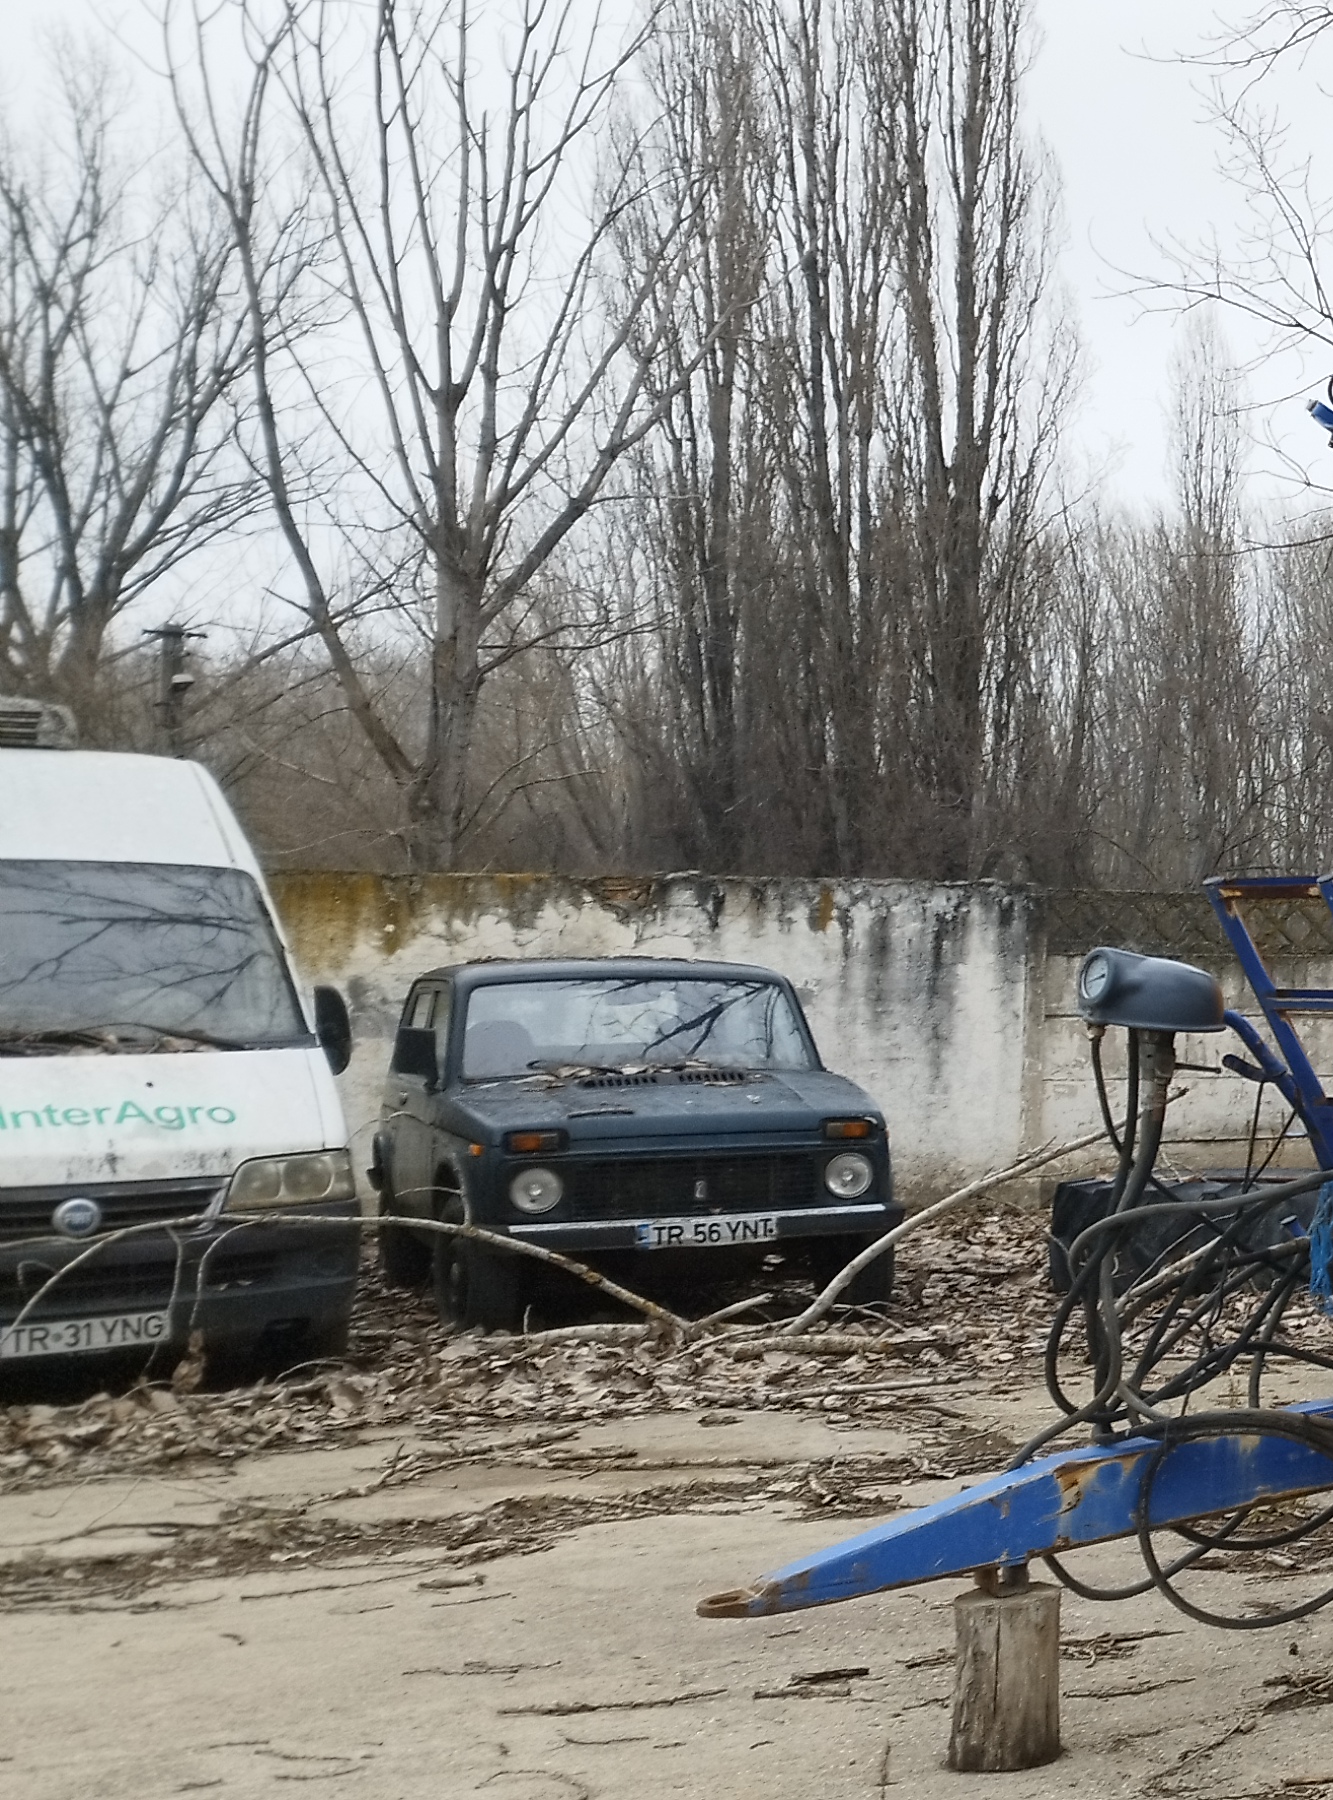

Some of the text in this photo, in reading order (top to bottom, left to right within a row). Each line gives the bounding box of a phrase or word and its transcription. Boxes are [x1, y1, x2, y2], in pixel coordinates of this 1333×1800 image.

[0, 1100, 237, 1131] InterAgro
[652, 1217, 773, 1246] TR 56 YNT
[11, 1314, 164, 1353] TR 31 YNG
